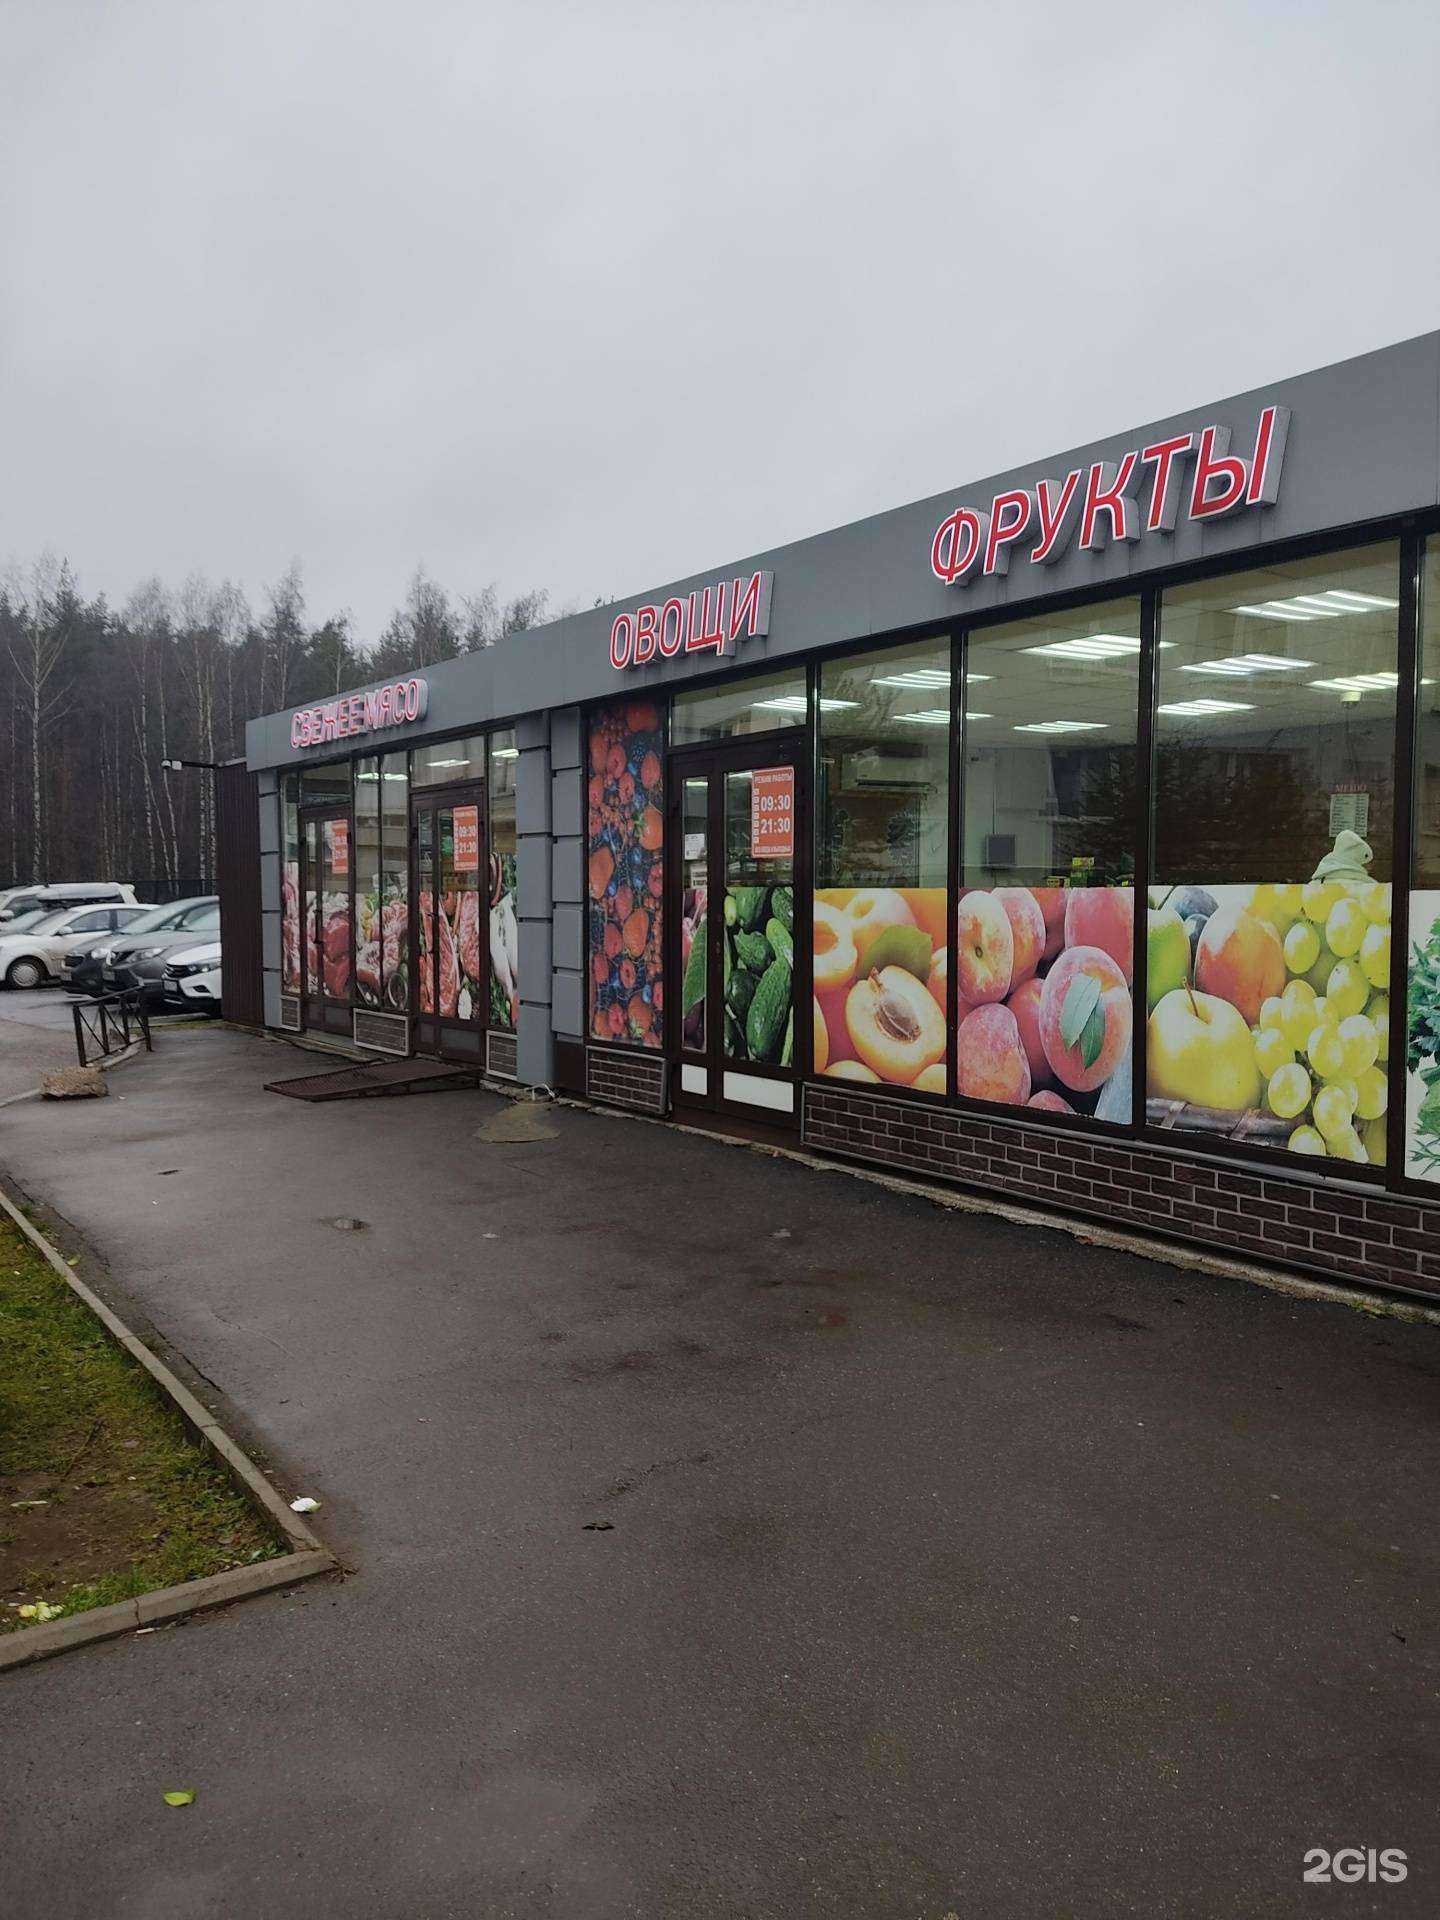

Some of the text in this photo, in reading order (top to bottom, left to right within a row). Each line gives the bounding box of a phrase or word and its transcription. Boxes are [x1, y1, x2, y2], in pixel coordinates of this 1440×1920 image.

[931, 405, 1279, 585] ФРУКТЫ
[609, 571, 764, 669] ОВОЩИ
[291, 679, 421, 748] СВЕЖЕЕ МЯСО
[761, 794, 791, 811] 09:30
[761, 817, 791, 834] 21:30
